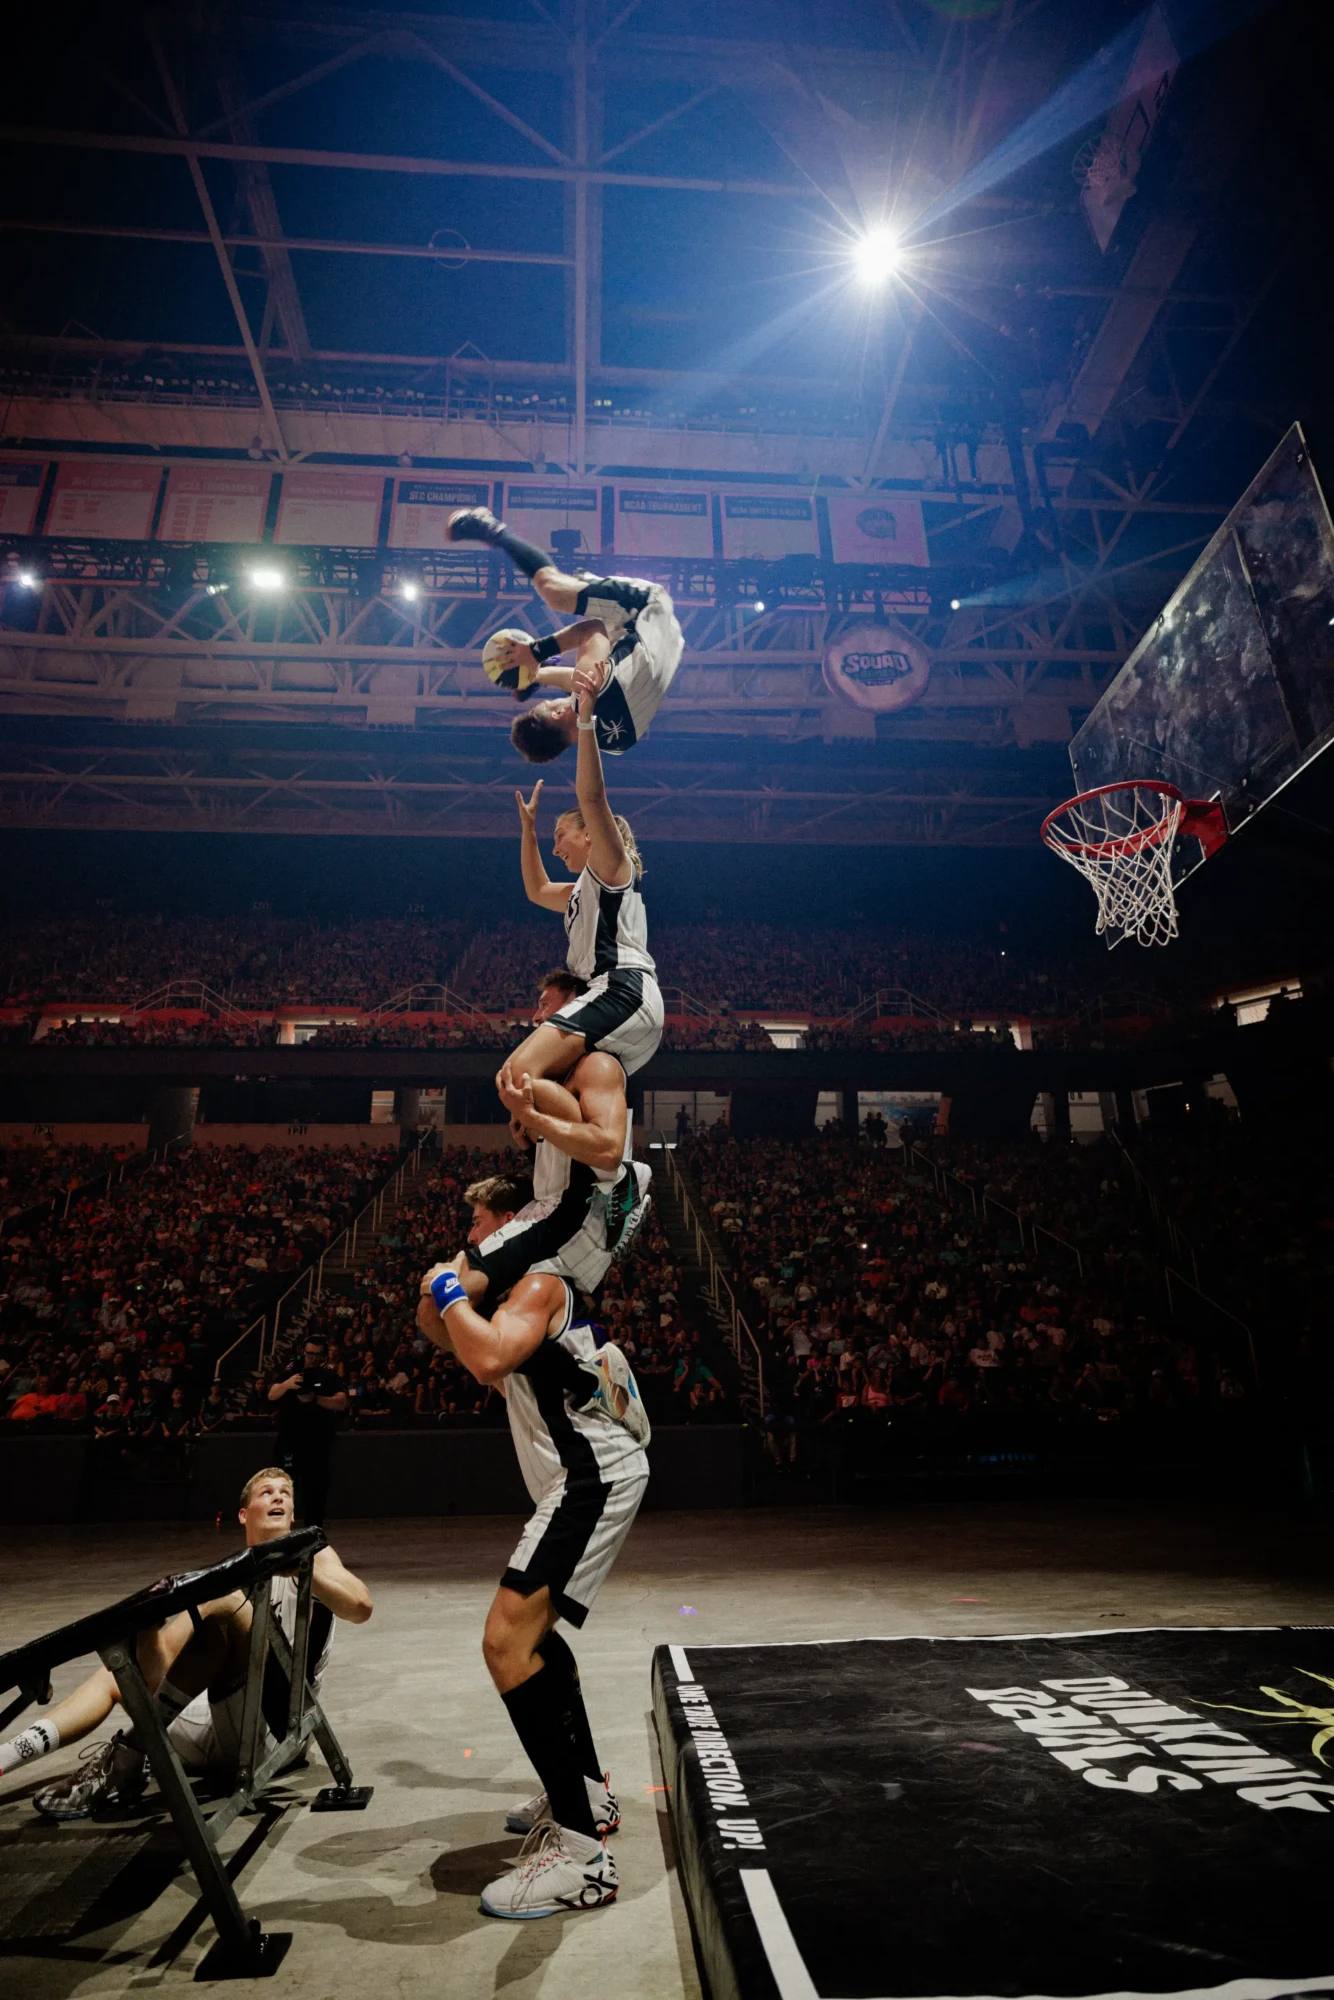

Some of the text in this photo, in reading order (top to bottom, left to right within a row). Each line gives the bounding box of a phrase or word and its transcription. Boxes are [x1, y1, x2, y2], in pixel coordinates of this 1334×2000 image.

[845, 654, 909, 673] SQUAD
[675, 1684, 767, 1850] ONE TRUE DIRECTION. UP!
[965, 1686, 1204, 1794] DEVILS
[1039, 1675, 1334, 1813] DUNKING
